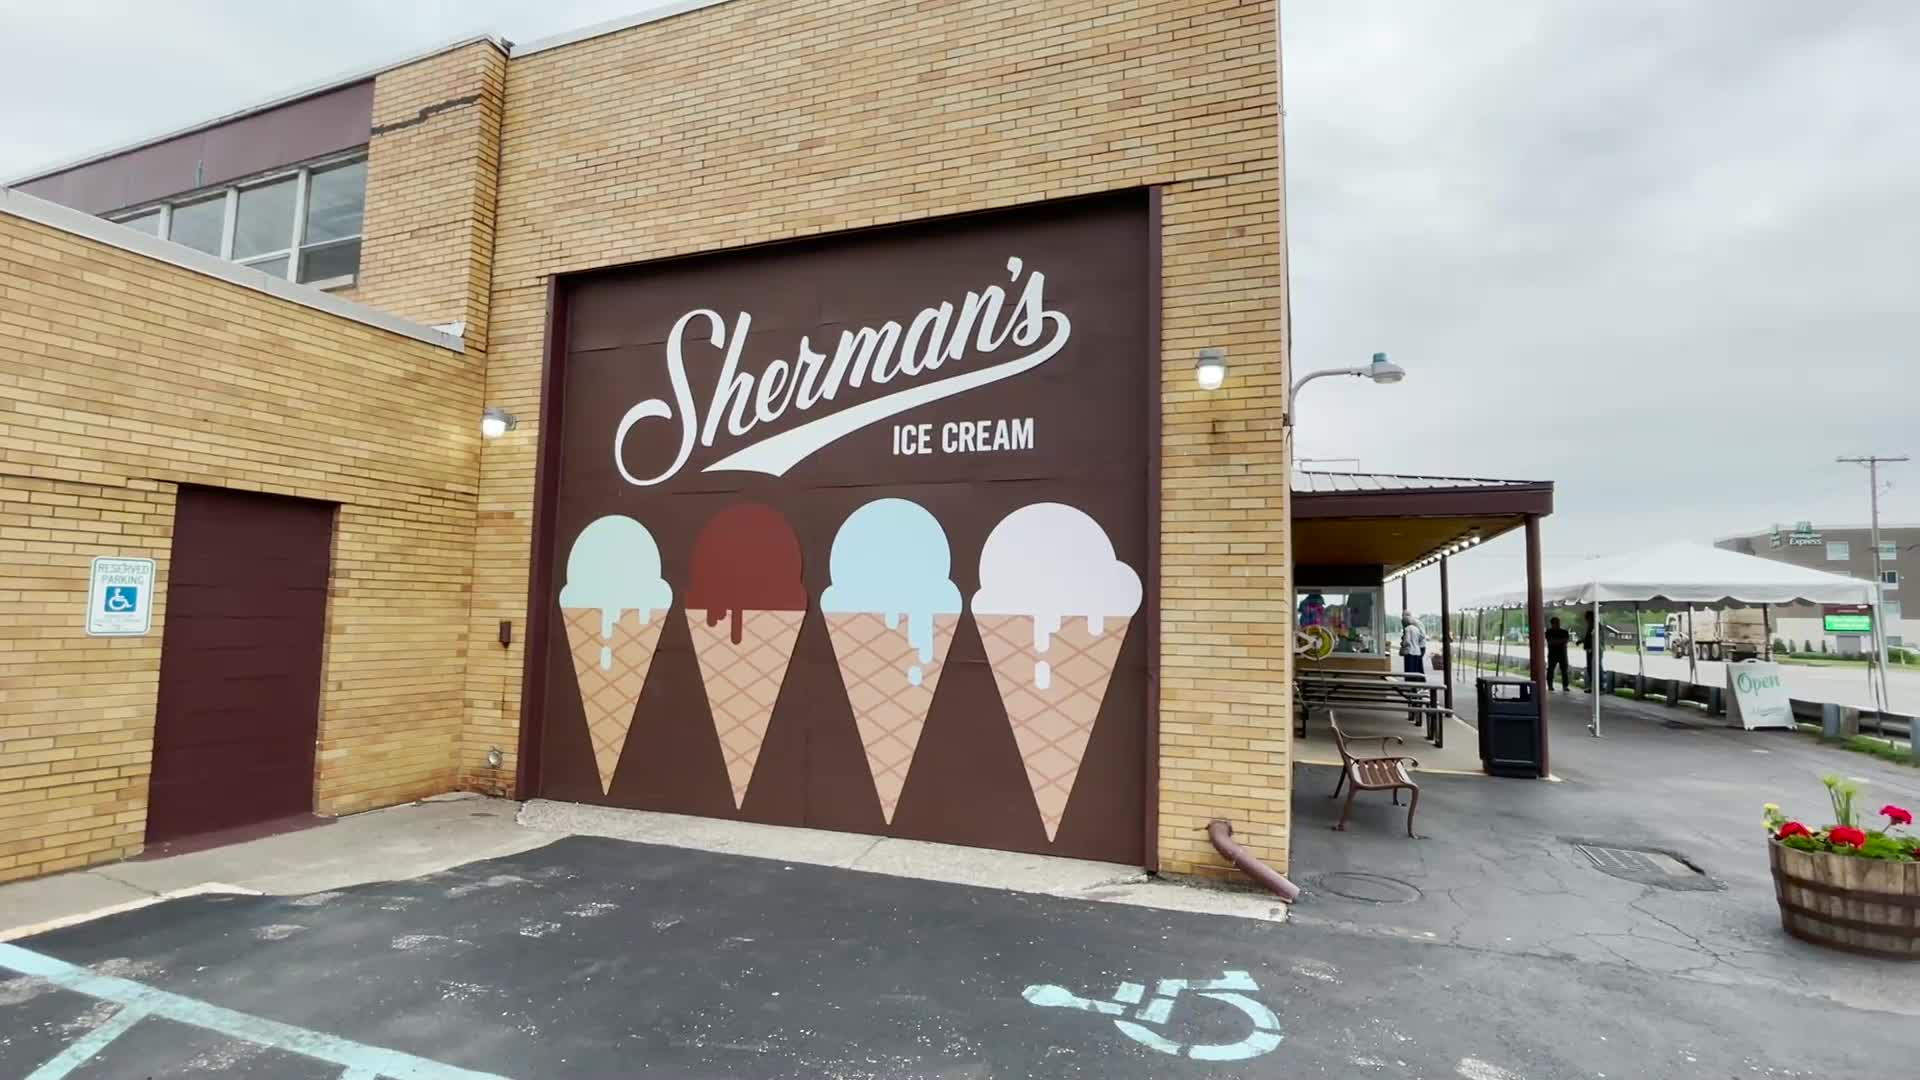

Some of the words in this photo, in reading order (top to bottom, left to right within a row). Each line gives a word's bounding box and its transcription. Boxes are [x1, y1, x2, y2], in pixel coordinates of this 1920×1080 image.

[614, 256, 1071, 487] Sherman's
[892, 424, 932, 456] ICE
[941, 418, 1035, 454] CREAM
[1789, 538, 1822, 547] Express
[98, 563, 150, 574] RESERVED
[102, 574, 144, 584] PARKING
[1737, 672, 1780, 696] Open
